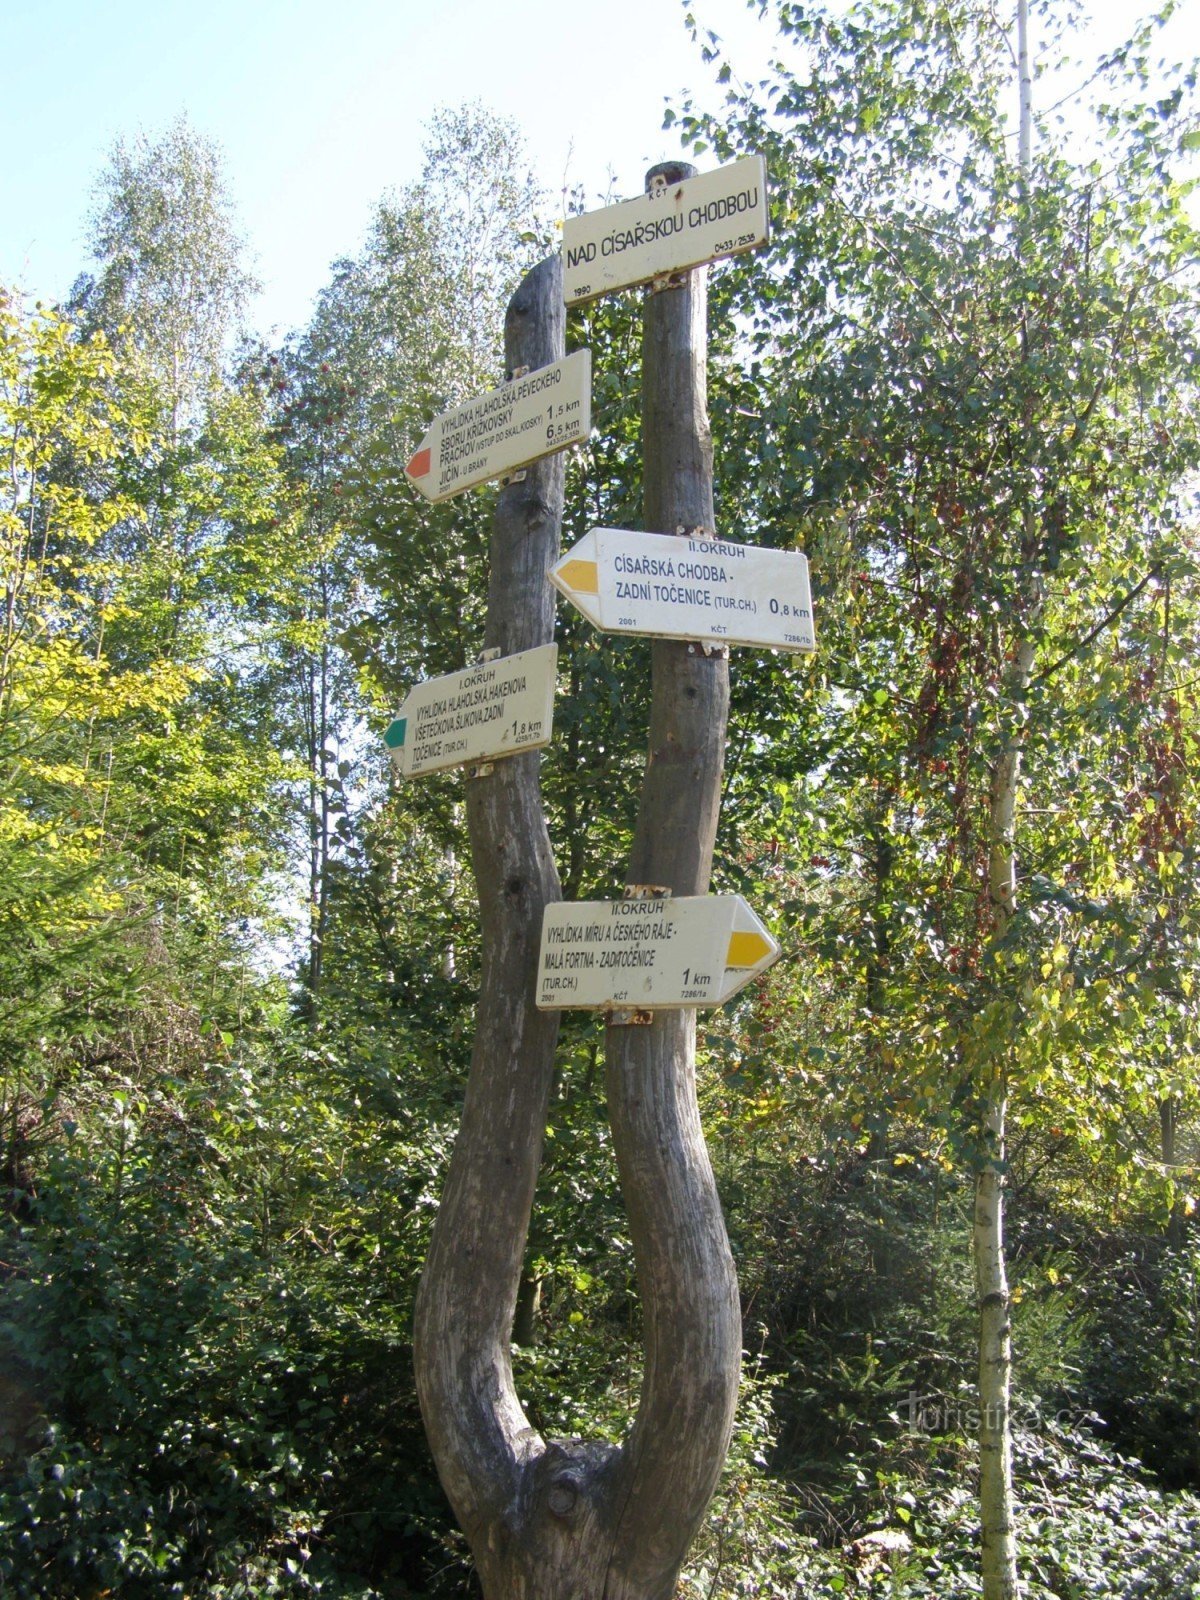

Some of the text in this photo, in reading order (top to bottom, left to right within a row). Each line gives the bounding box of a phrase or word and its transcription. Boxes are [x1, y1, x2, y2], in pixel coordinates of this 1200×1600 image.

[648, 188, 668, 200] KČT
[567, 188, 758, 269] NAD CÍSAŘSKOU CHODBOU
[574, 285, 591, 297] 1990
[566, 400, 580, 412] km
[440, 408, 514, 453] SBORU KŘÍŽKOVSKÝ
[441, 409, 473, 435] VYHLÍDKA
[565, 419, 580, 432] km
[440, 440, 477, 467] PRACHOV
[496, 430, 504, 443] DO
[439, 464, 459, 485] JIČÍN
[463, 466, 468, 476] U
[468, 457, 488, 473] BRÁNY
[614, 552, 675, 577] CÍSAŘSKÁ
[678, 563, 727, 584] CHODBA
[615, 579, 652, 601] ZADNÍ
[654, 583, 711, 607] TOČENICE
[618, 617, 637, 626] 2001
[792, 605, 810, 619] km
[711, 624, 728, 634] KČT
[416, 699, 447, 722] VYHLÍDKA
[528, 721, 542, 732] km
[412, 741, 442, 763] TOČENICE
[547, 925, 583, 944] VYHLÍDKA
[584, 923, 605, 943] MÍRU
[605, 927, 611, 942] A
[613, 921, 651, 941] ČESKÉHO
[651, 920, 674, 940] RÁJE
[545, 949, 565, 970] MALÁ
[565, 952, 594, 969] FORTNA
[683, 968, 711, 986] 1 km
